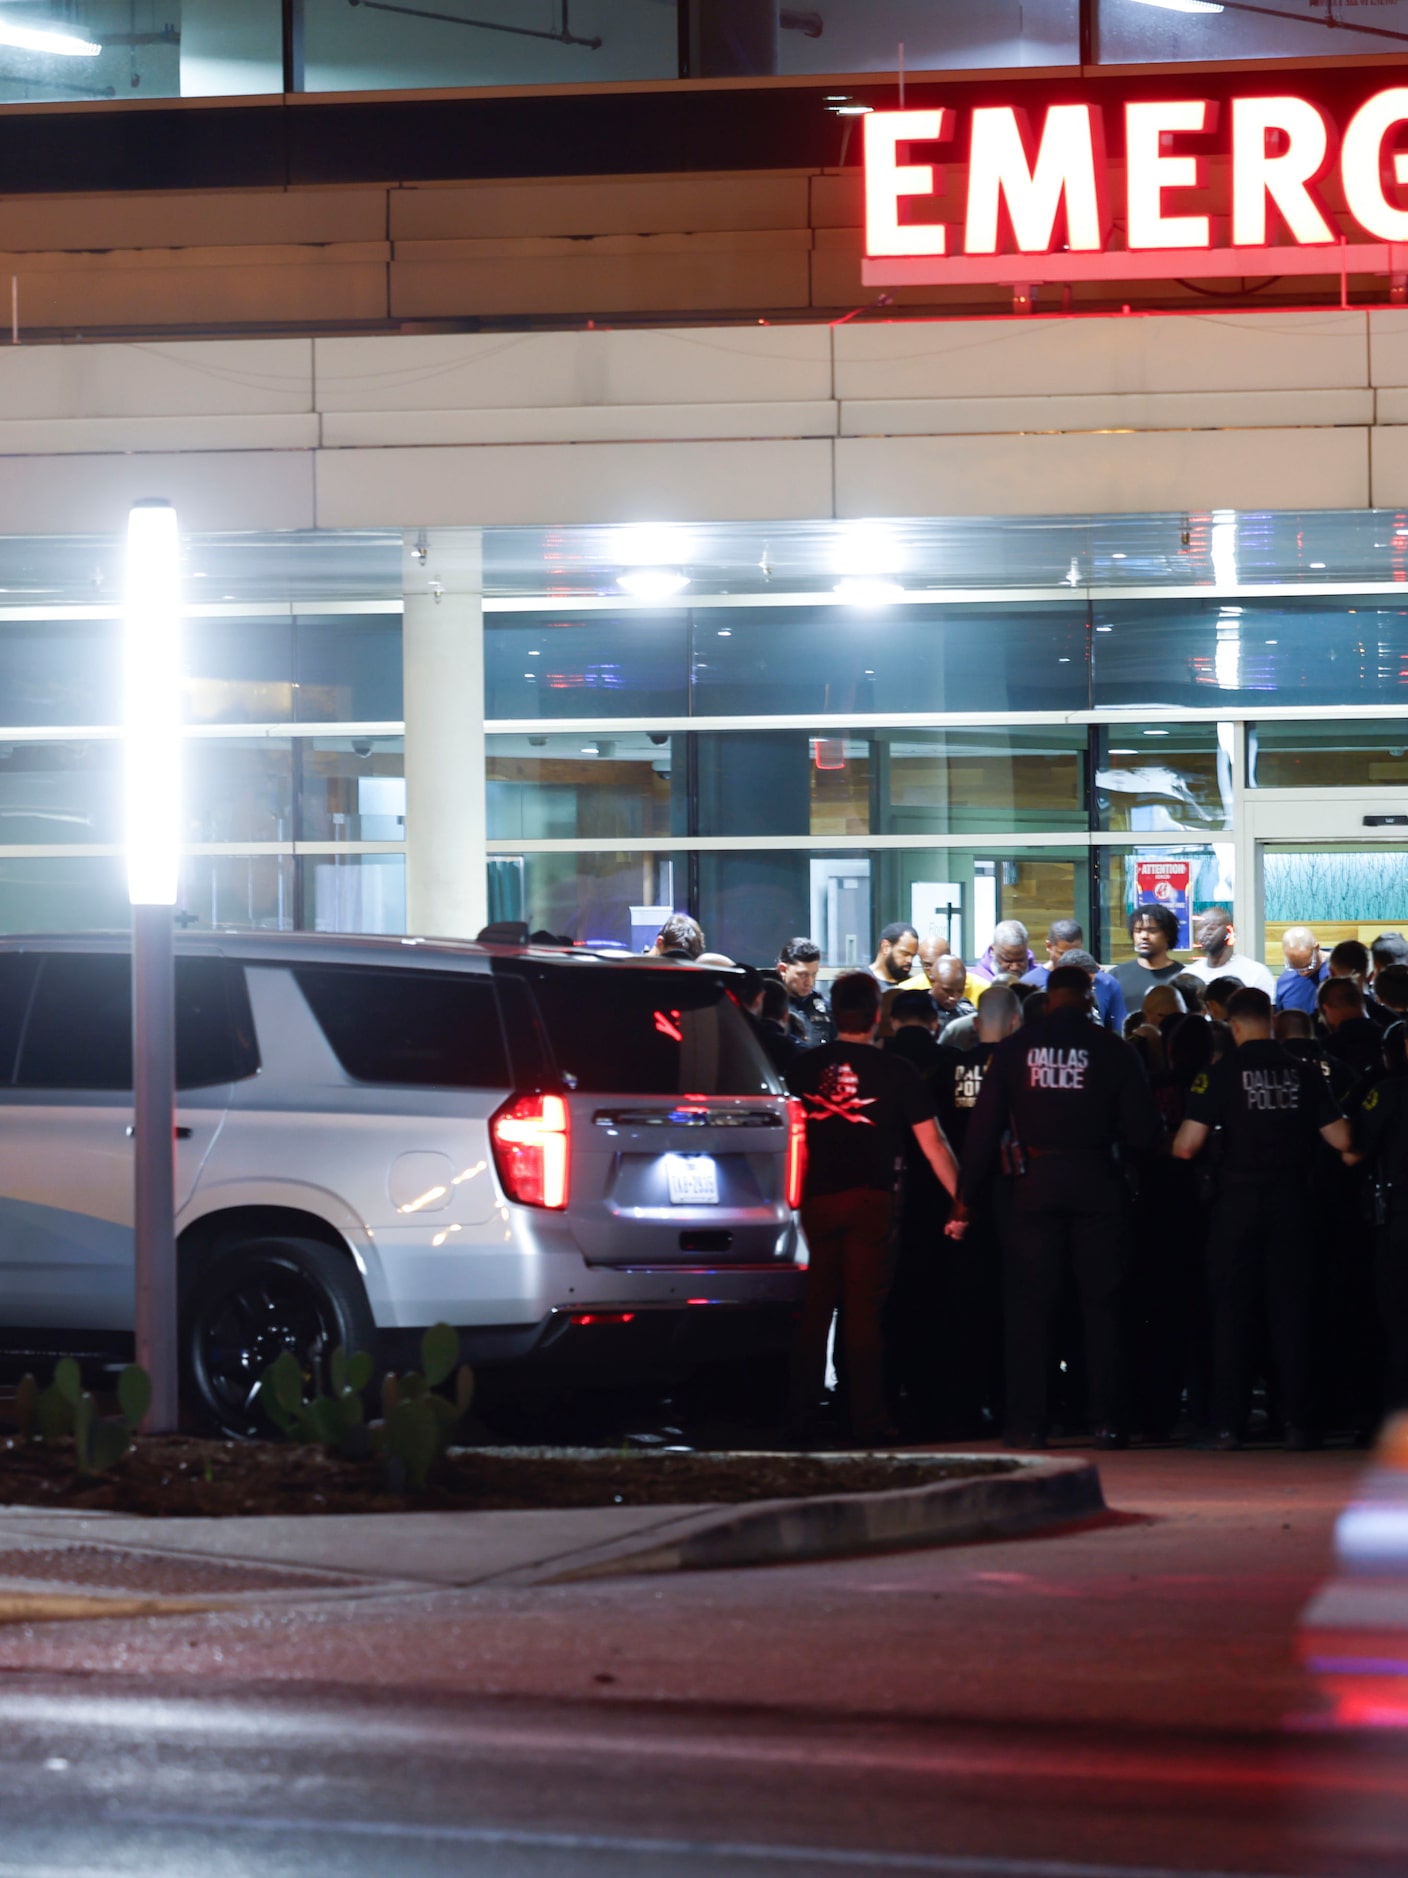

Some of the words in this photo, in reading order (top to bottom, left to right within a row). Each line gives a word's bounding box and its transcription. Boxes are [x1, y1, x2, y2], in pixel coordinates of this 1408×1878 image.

[1027, 1047, 1089, 1068] DALLAS
[1030, 1068, 1085, 1090] POLICE
[1242, 1069, 1300, 1090] DALLAS
[1248, 1088, 1299, 1110] POLICE
